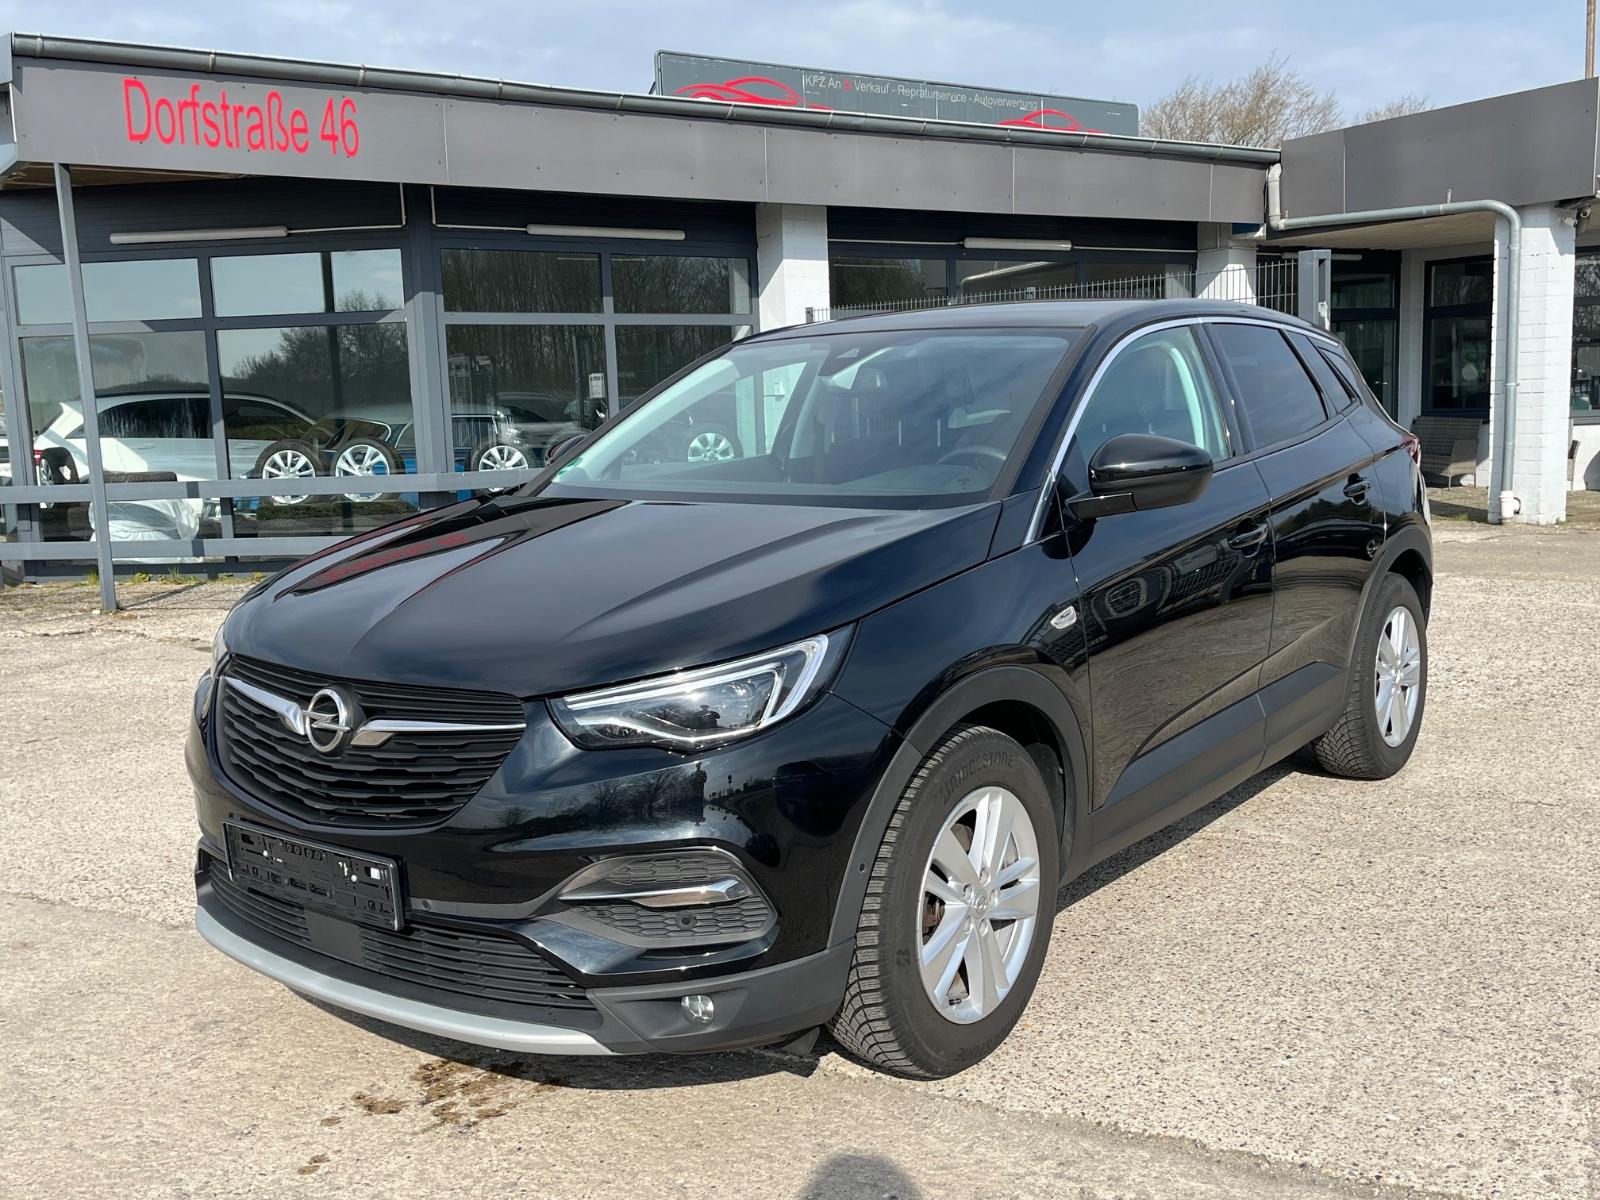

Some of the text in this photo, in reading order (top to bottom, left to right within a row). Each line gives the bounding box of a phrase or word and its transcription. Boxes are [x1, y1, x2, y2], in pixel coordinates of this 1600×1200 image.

[123, 78, 360, 157] Dorfstraße 46
[805, 74, 827, 88] KFZ
[828, 77, 841, 89] An
[853, 79, 889, 95] Verkauf
[973, 93, 1038, 111] Autoverwertung
